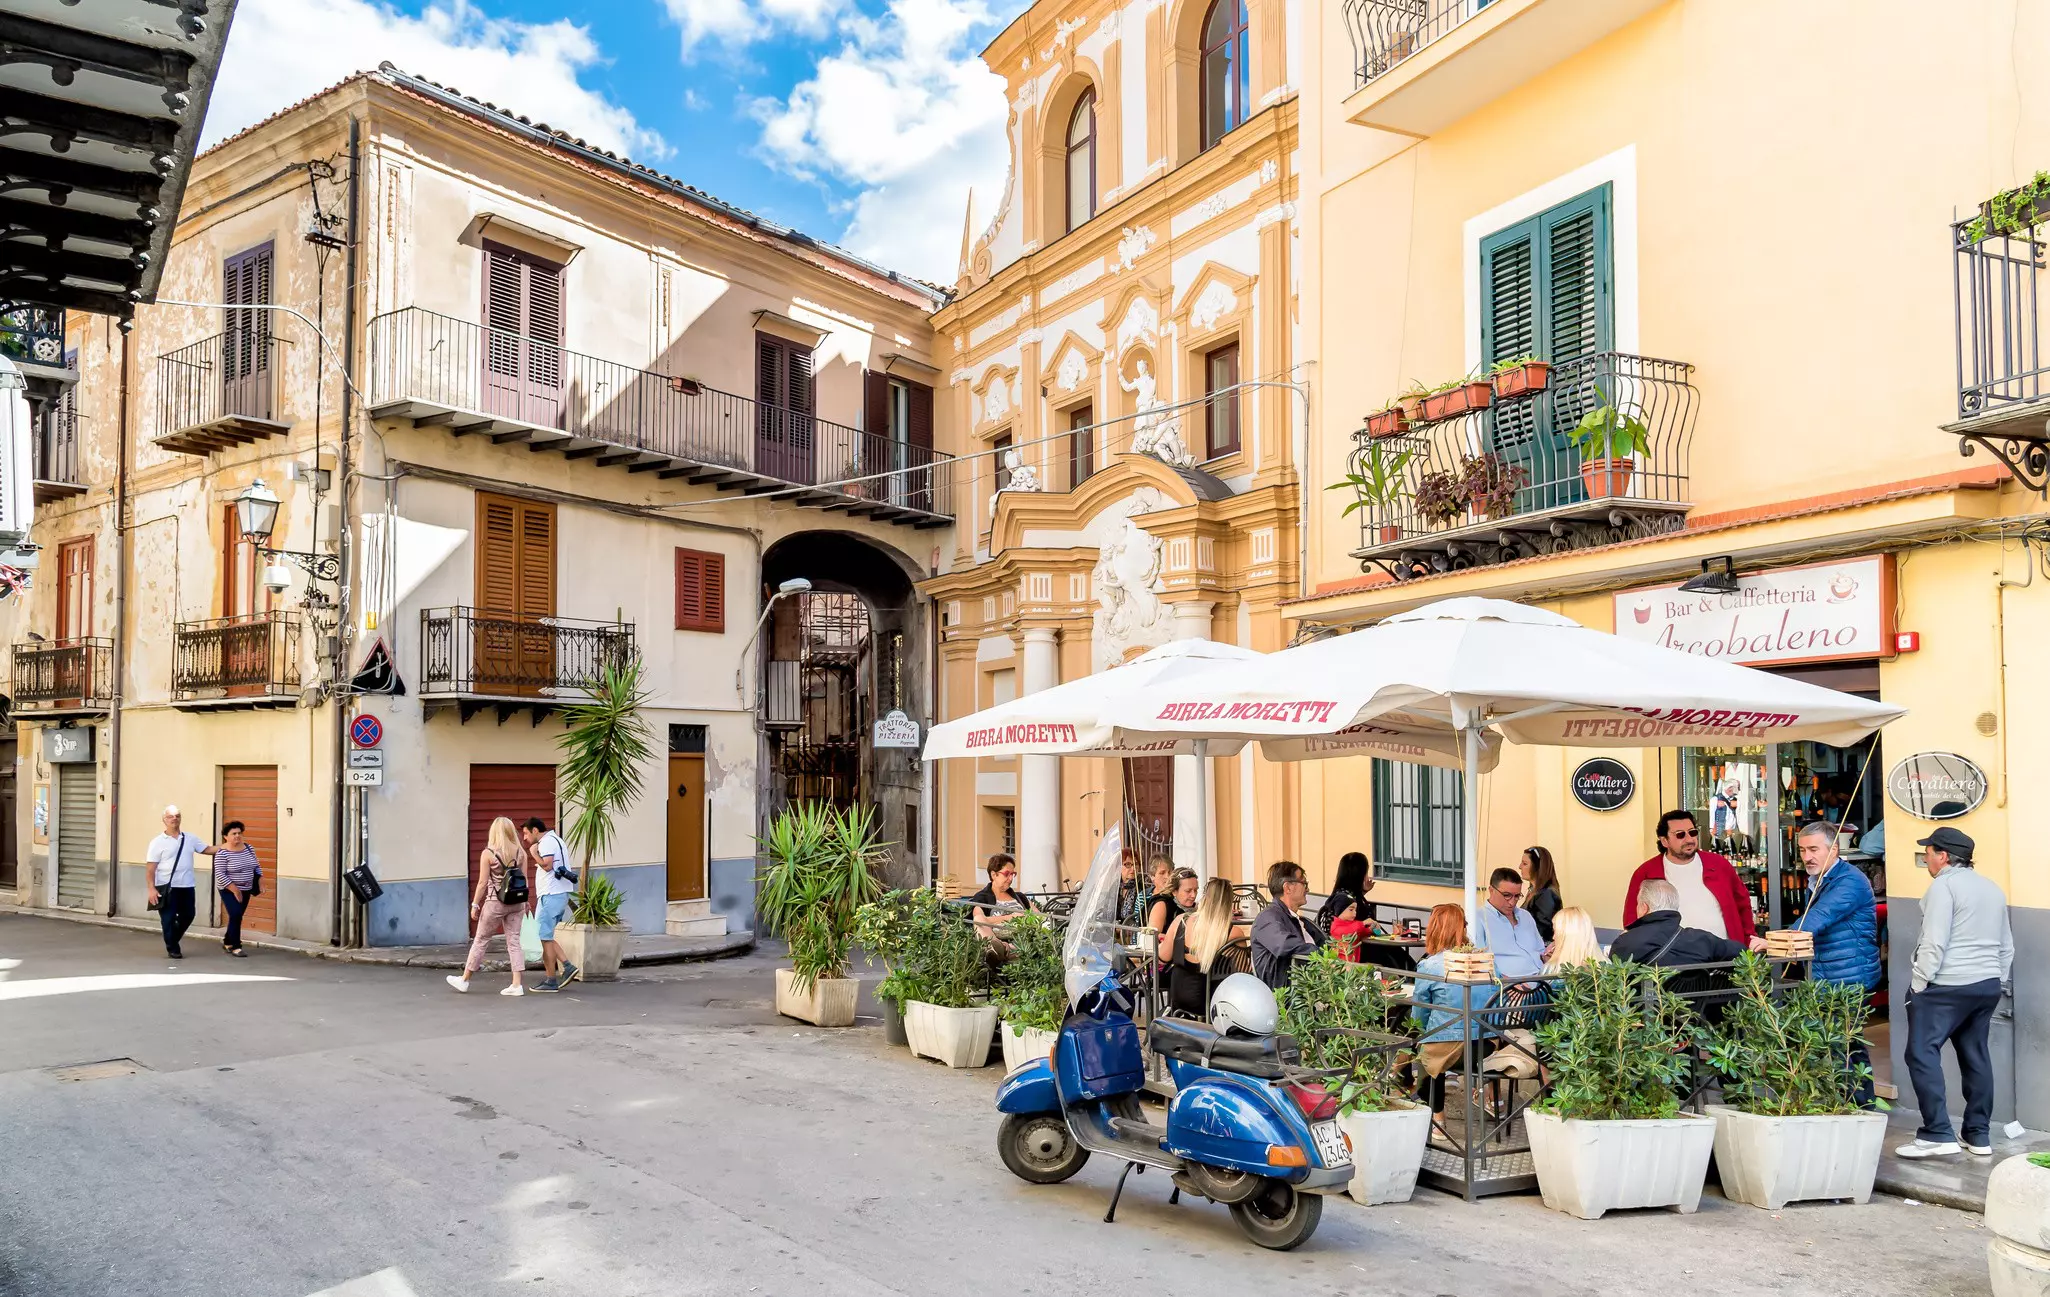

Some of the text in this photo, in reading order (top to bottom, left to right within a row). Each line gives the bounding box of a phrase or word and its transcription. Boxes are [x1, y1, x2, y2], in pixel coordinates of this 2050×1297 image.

[1665, 585, 1816, 619] Bar & Caffetteria
[1156, 701, 1338, 723] BIRRA MORETTI
[1657, 708, 1800, 728] MORETTI
[878, 719, 916, 732] TRATTORIA
[878, 732, 915, 740] PIZZERIA
[966, 724, 1078, 749] BIRRA MORETTI
[353, 773, 375, 781] 0-24
[1577, 775, 1628, 788] Cavaliere
[1897, 775, 1976, 790] Cavaliere
[1315, 1126, 1330, 1144] AC
[1324, 1143, 1350, 1164] 4346
